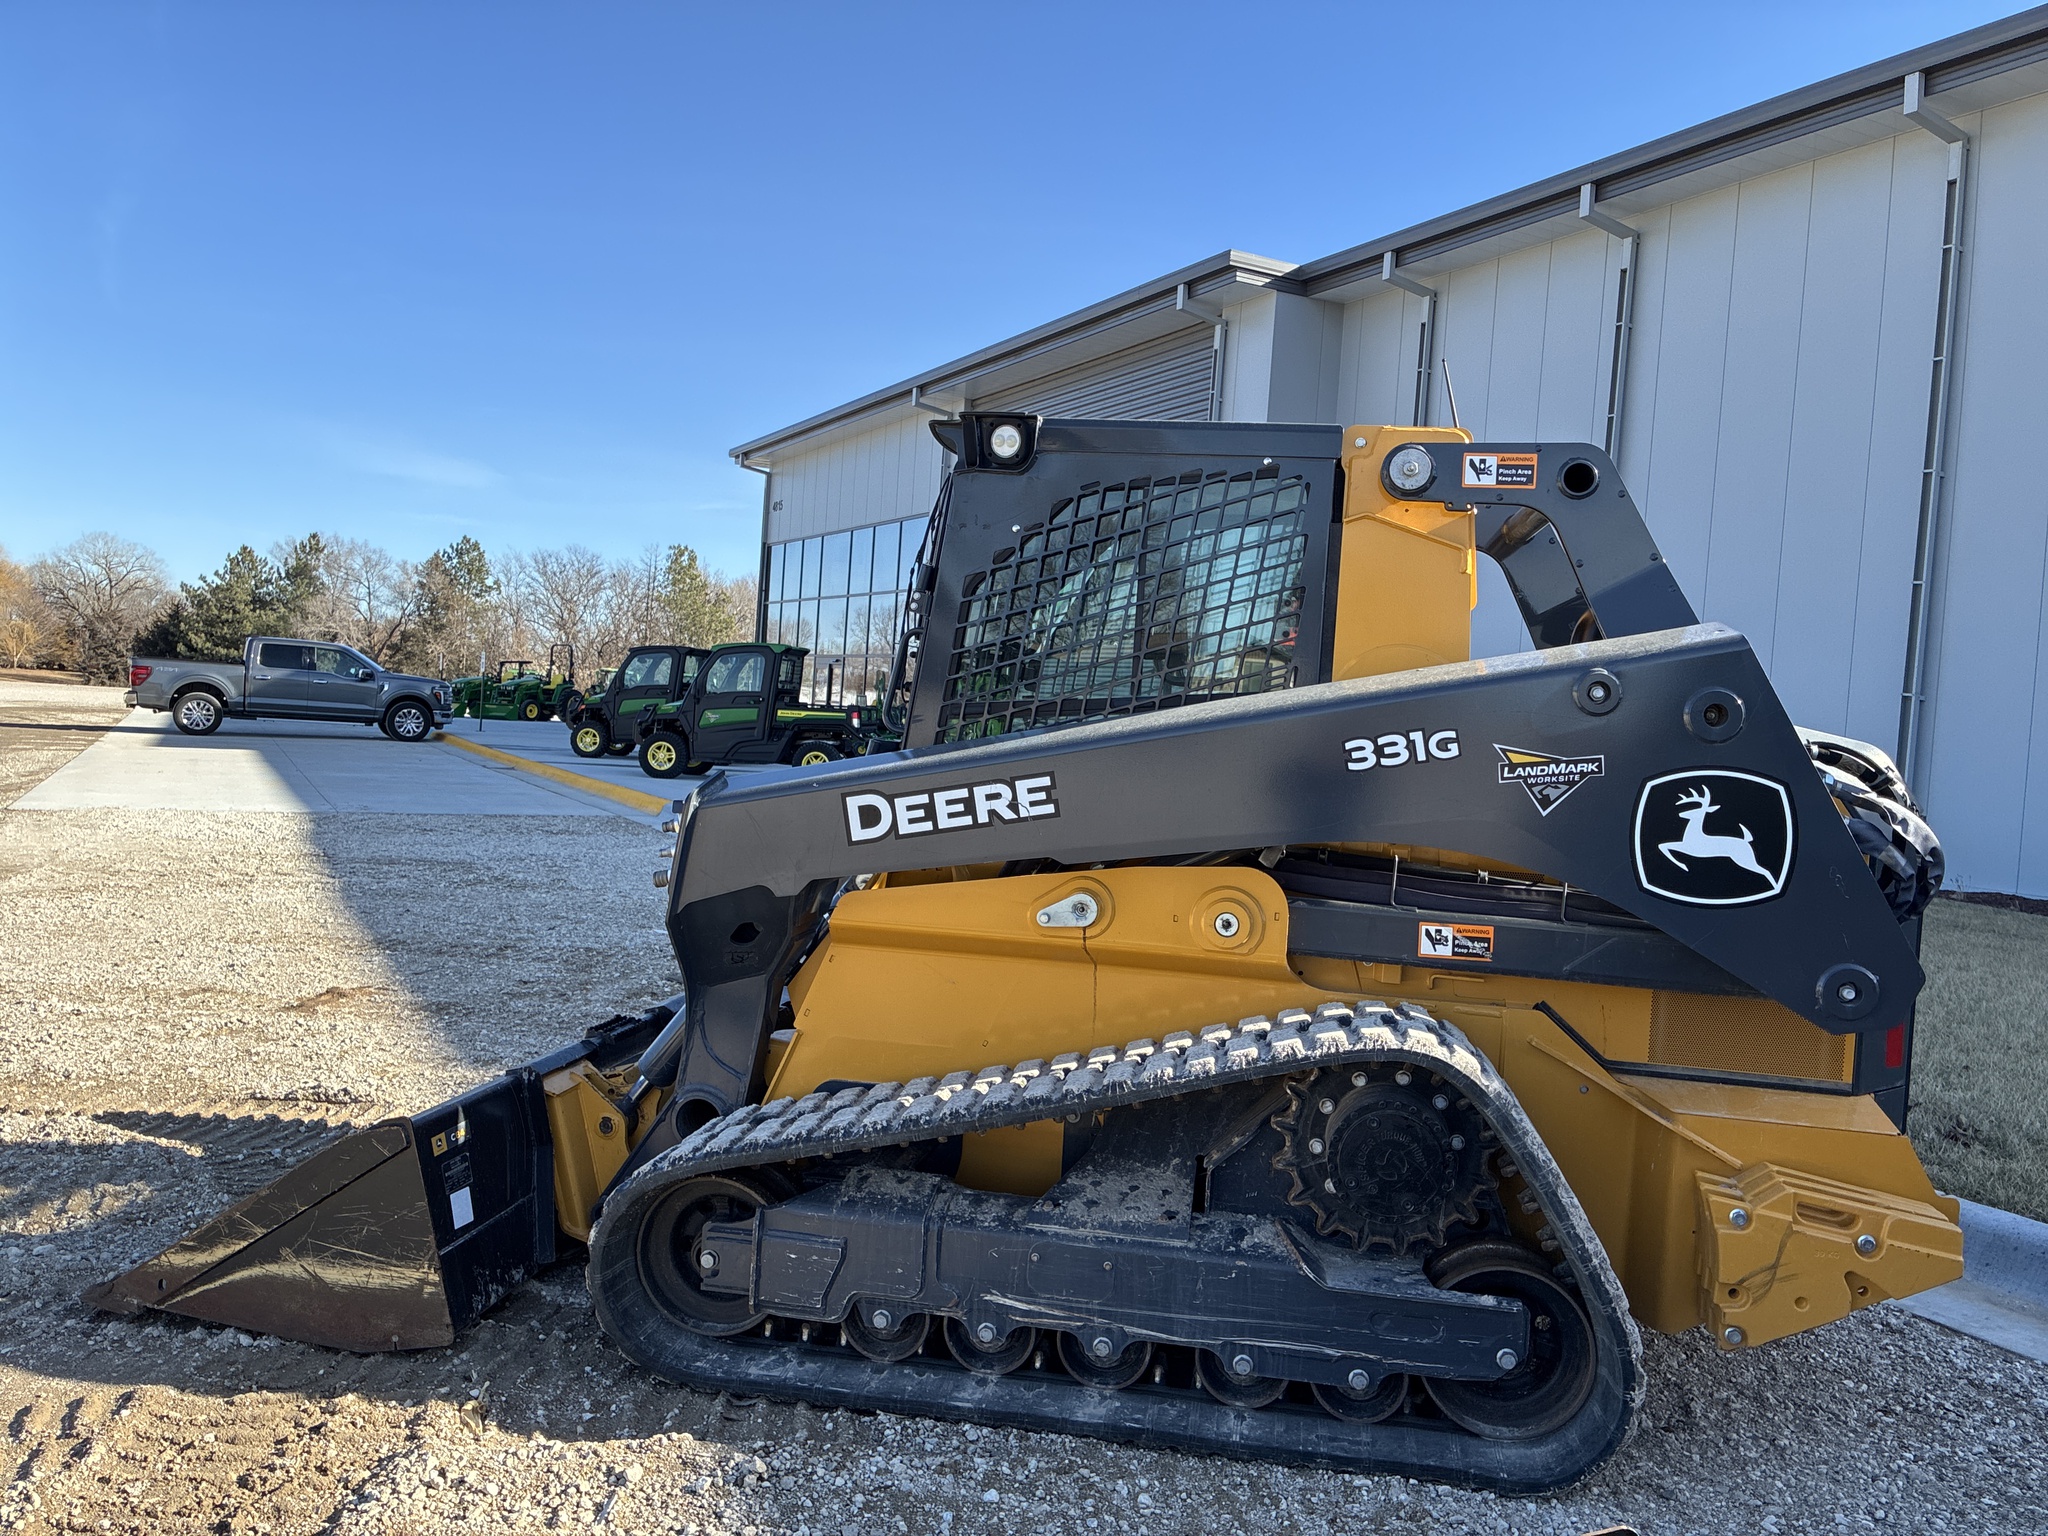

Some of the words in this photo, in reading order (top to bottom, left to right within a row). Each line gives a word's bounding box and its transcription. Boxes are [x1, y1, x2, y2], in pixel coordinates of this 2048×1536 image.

[1344, 730, 1460, 771] 331G
[1503, 762, 1600, 778] LANDMARK
[1527, 774, 1580, 784] WORKSITE
[845, 776, 1055, 842] DEERE
